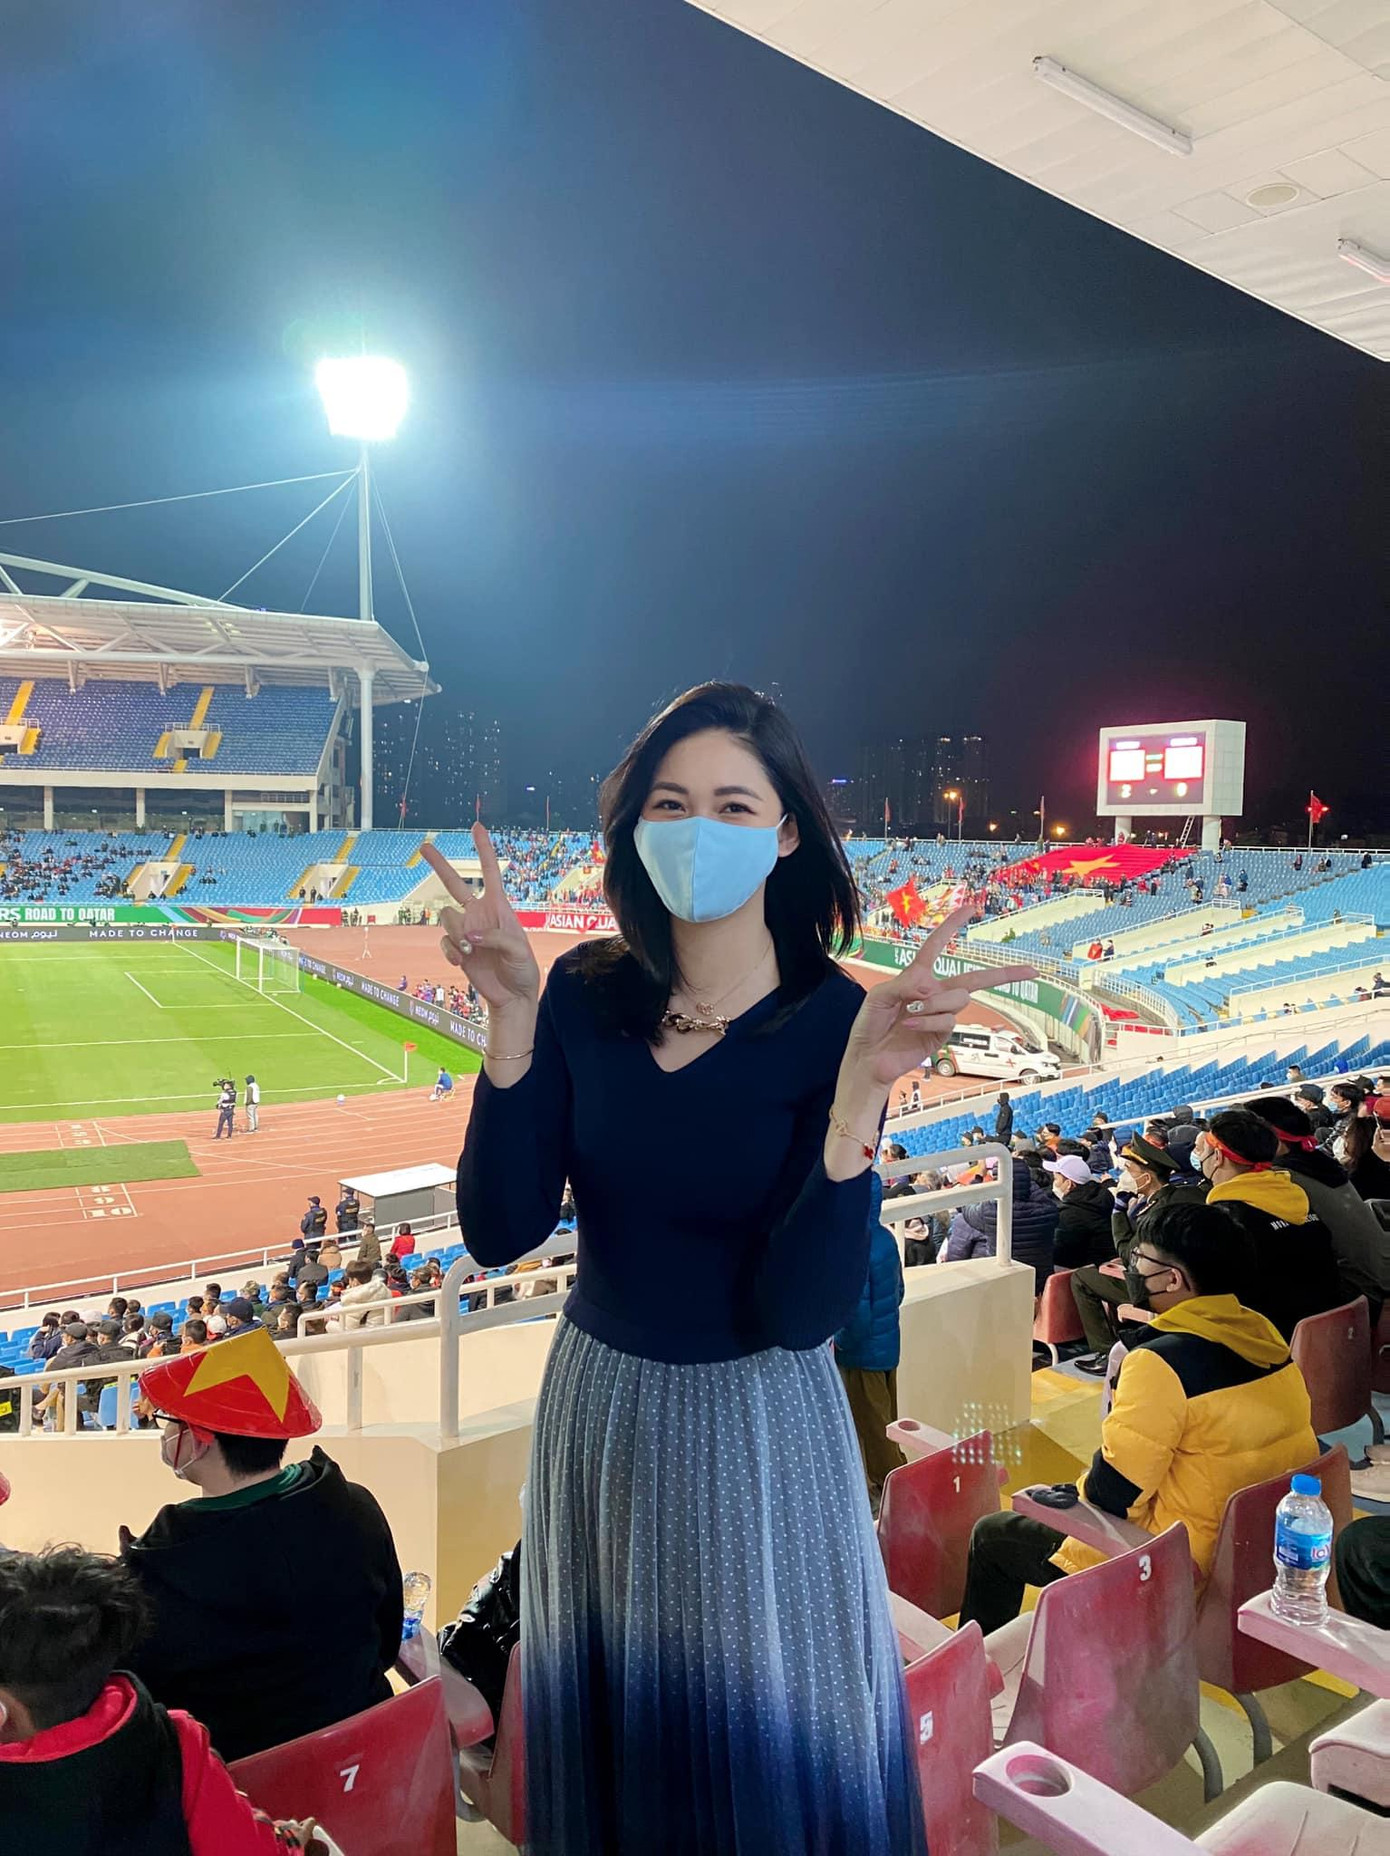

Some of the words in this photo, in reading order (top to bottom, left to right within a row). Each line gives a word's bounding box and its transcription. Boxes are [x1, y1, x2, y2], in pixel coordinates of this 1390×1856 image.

[25, 907, 57, 921] ROAD
[60, 907, 75, 921] TO
[78, 907, 116, 921] QATAR
[550, 914, 584, 928] ASIAN
[129, 929, 145, 937] TO
[150, 929, 198, 937] CHANGE
[450, 1020, 466, 1038] MADE
[467, 1028, 476, 1042] TO
[953, 1476, 961, 1493] 1
[1139, 1555, 1152, 1581] 3
[919, 1711, 933, 1745] 5
[340, 1764, 360, 1792] 7
